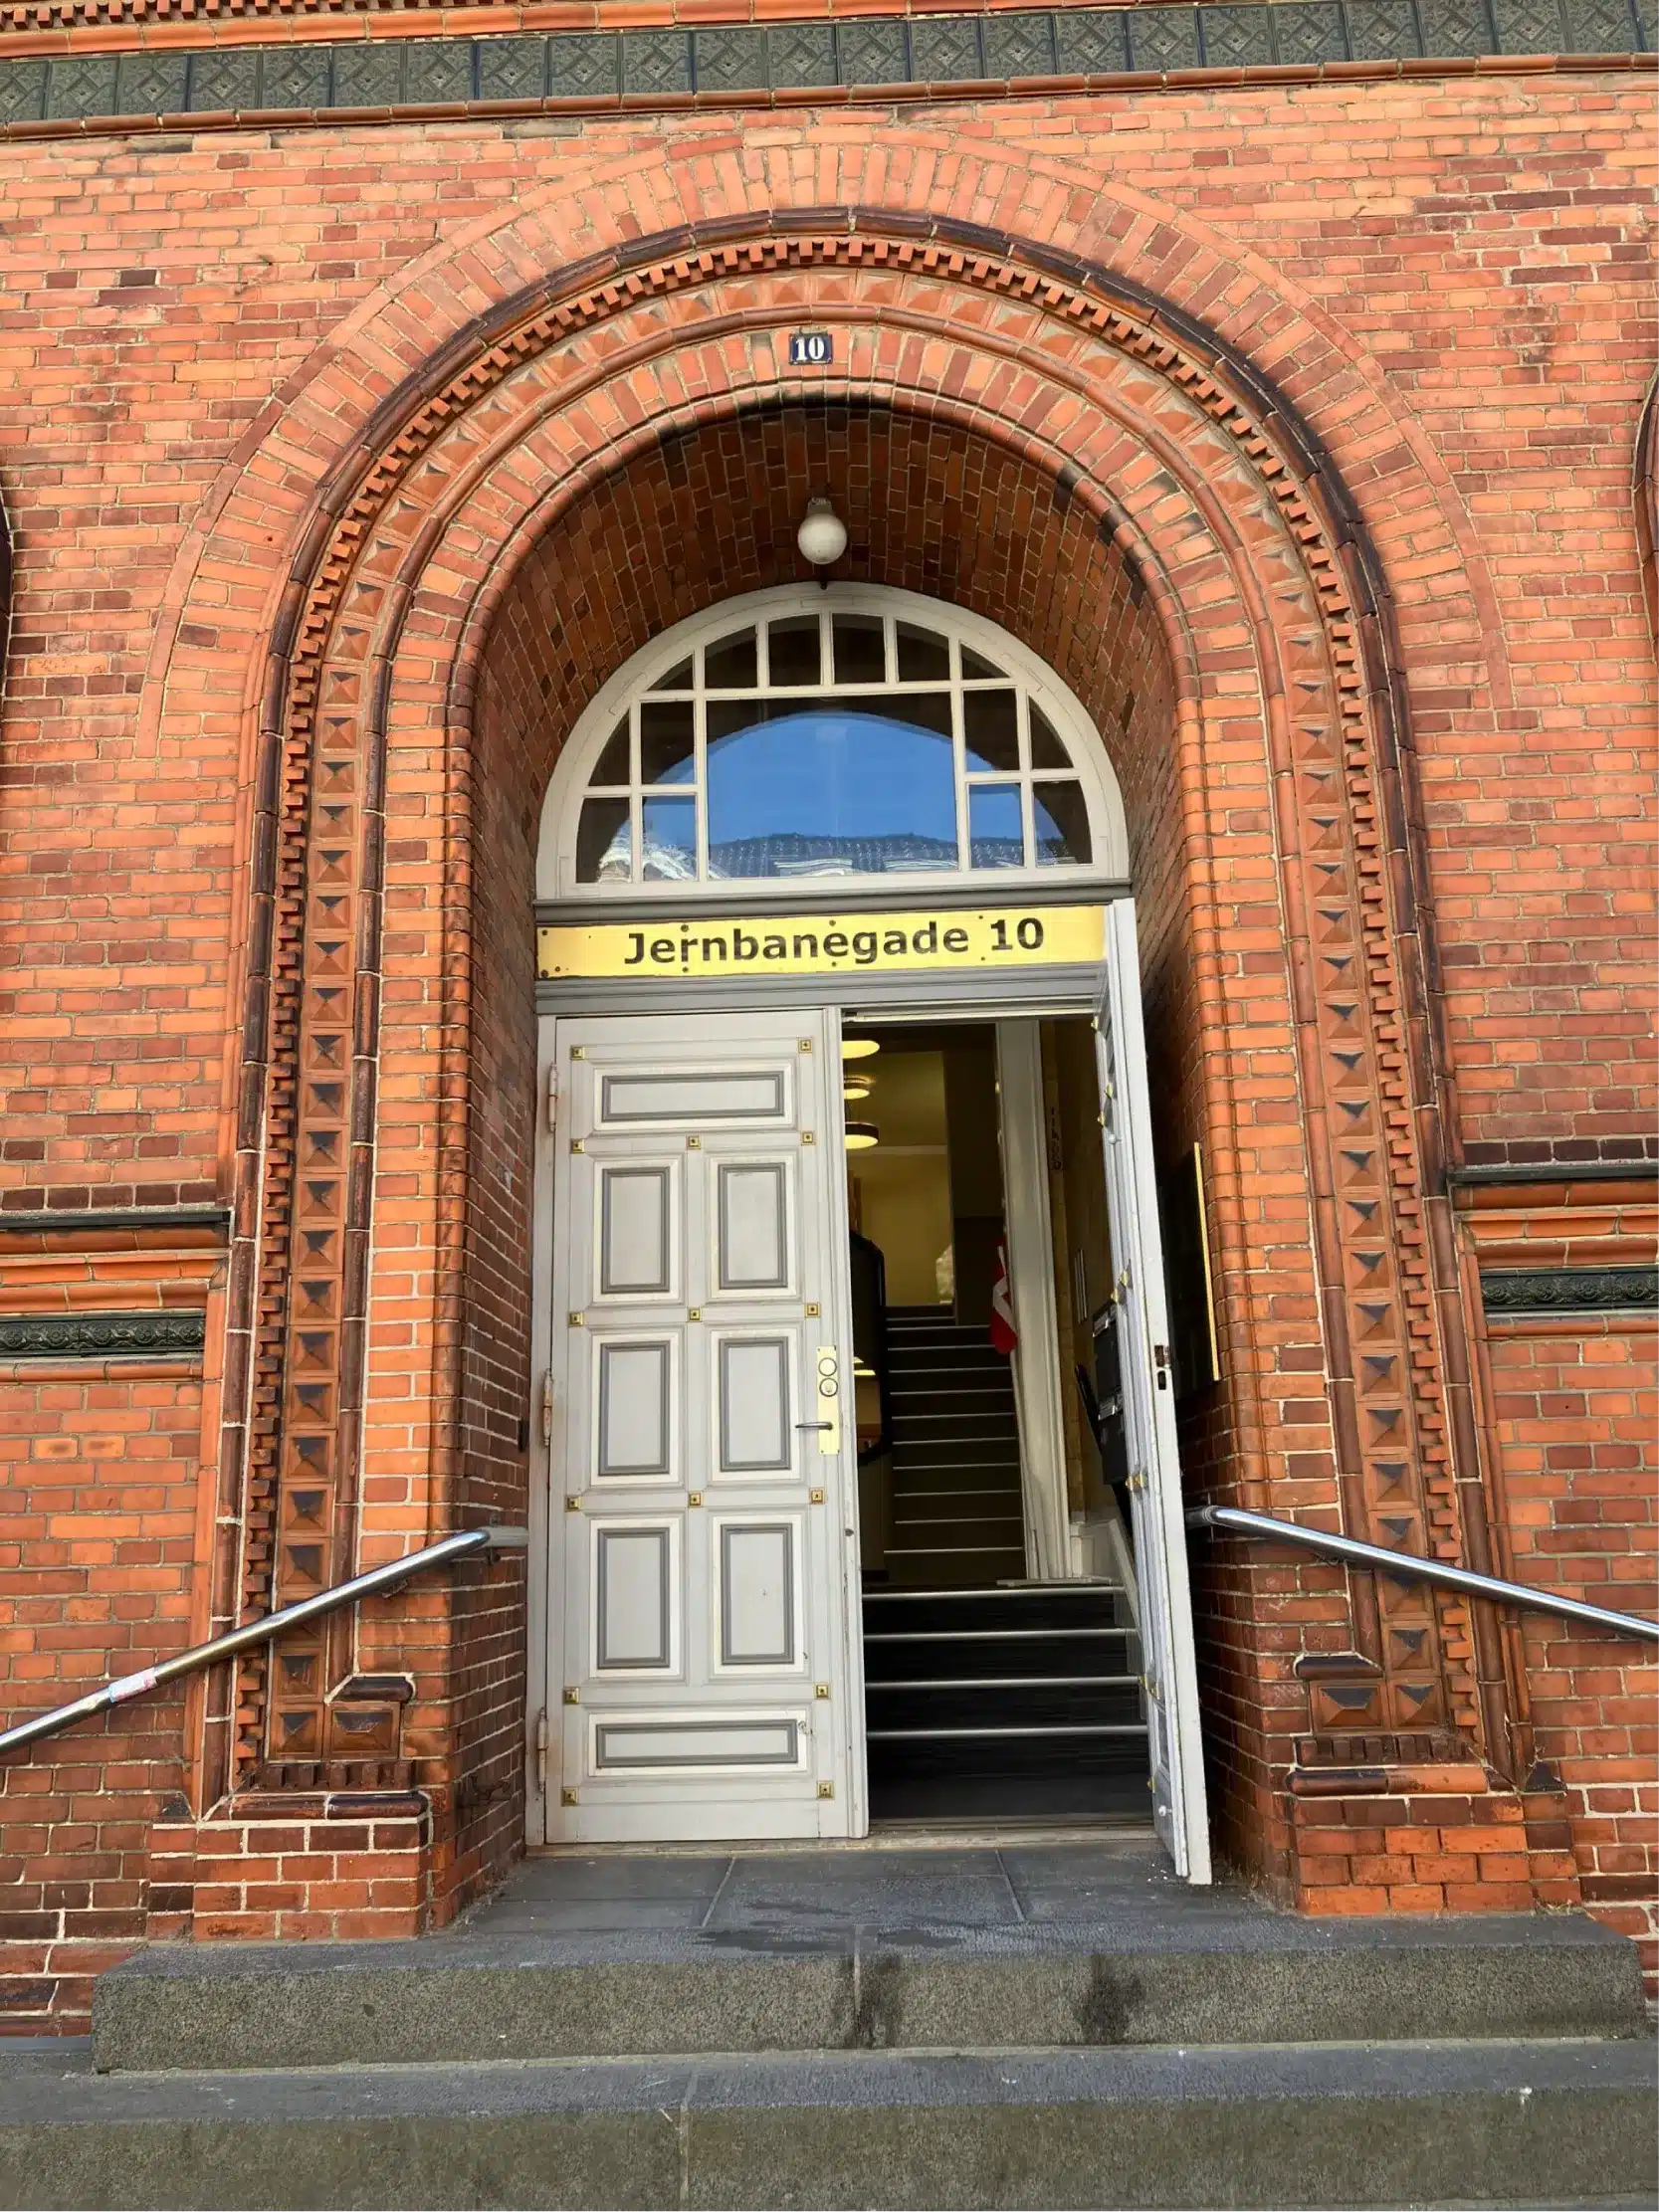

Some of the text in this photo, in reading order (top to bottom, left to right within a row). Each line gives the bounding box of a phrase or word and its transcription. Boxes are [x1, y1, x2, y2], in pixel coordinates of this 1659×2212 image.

[795, 336, 825, 361] 10
[624, 917, 1044, 965] Jernbanegade 10
